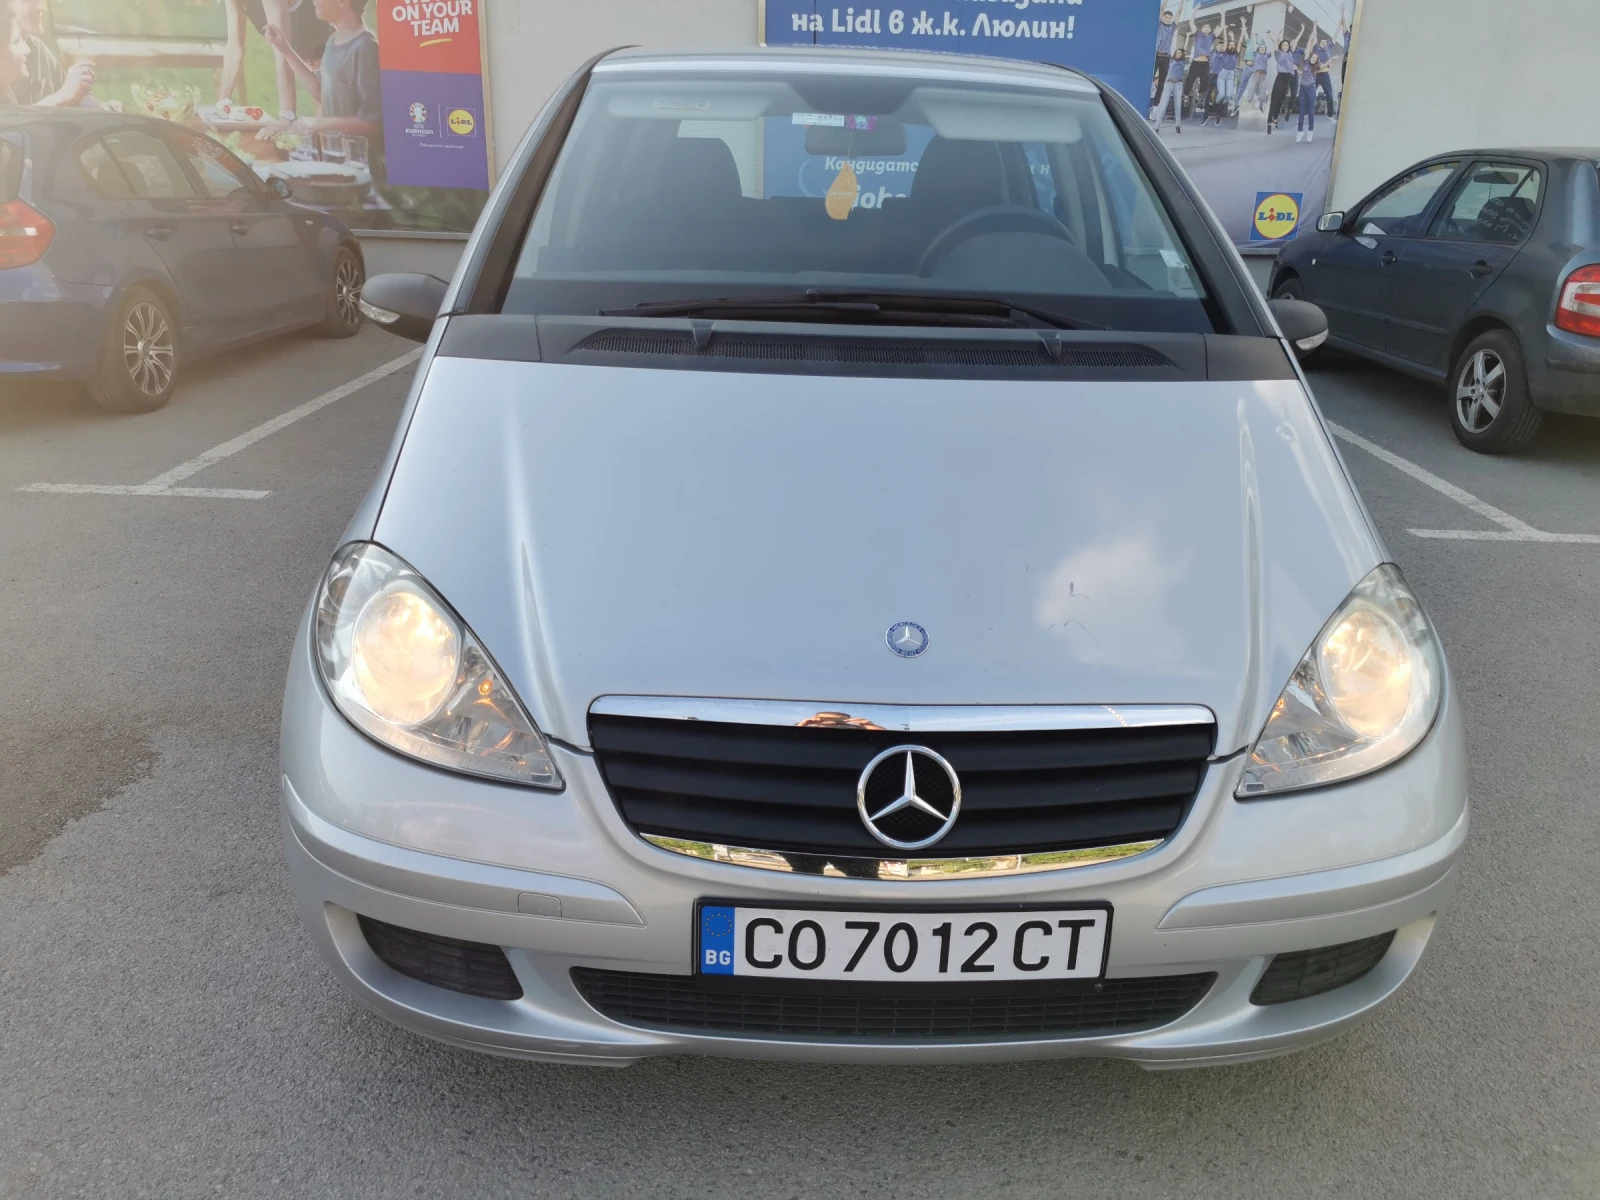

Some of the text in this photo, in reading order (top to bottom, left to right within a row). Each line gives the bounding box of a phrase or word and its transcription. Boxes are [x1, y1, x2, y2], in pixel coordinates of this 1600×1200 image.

[392, 0, 473, 22] ON YOUR
[410, 17, 460, 36] TEAM
[791, 13, 825, 32] на
[831, 7, 882, 34] Lidl
[911, 10, 966, 36] ж.к.
[971, 12, 1076, 40] Люлин!
[1257, 207, 1295, 222] LIDL
[745, 917, 1097, 974] CO 7012 CT
[705, 949, 731, 966] BG
